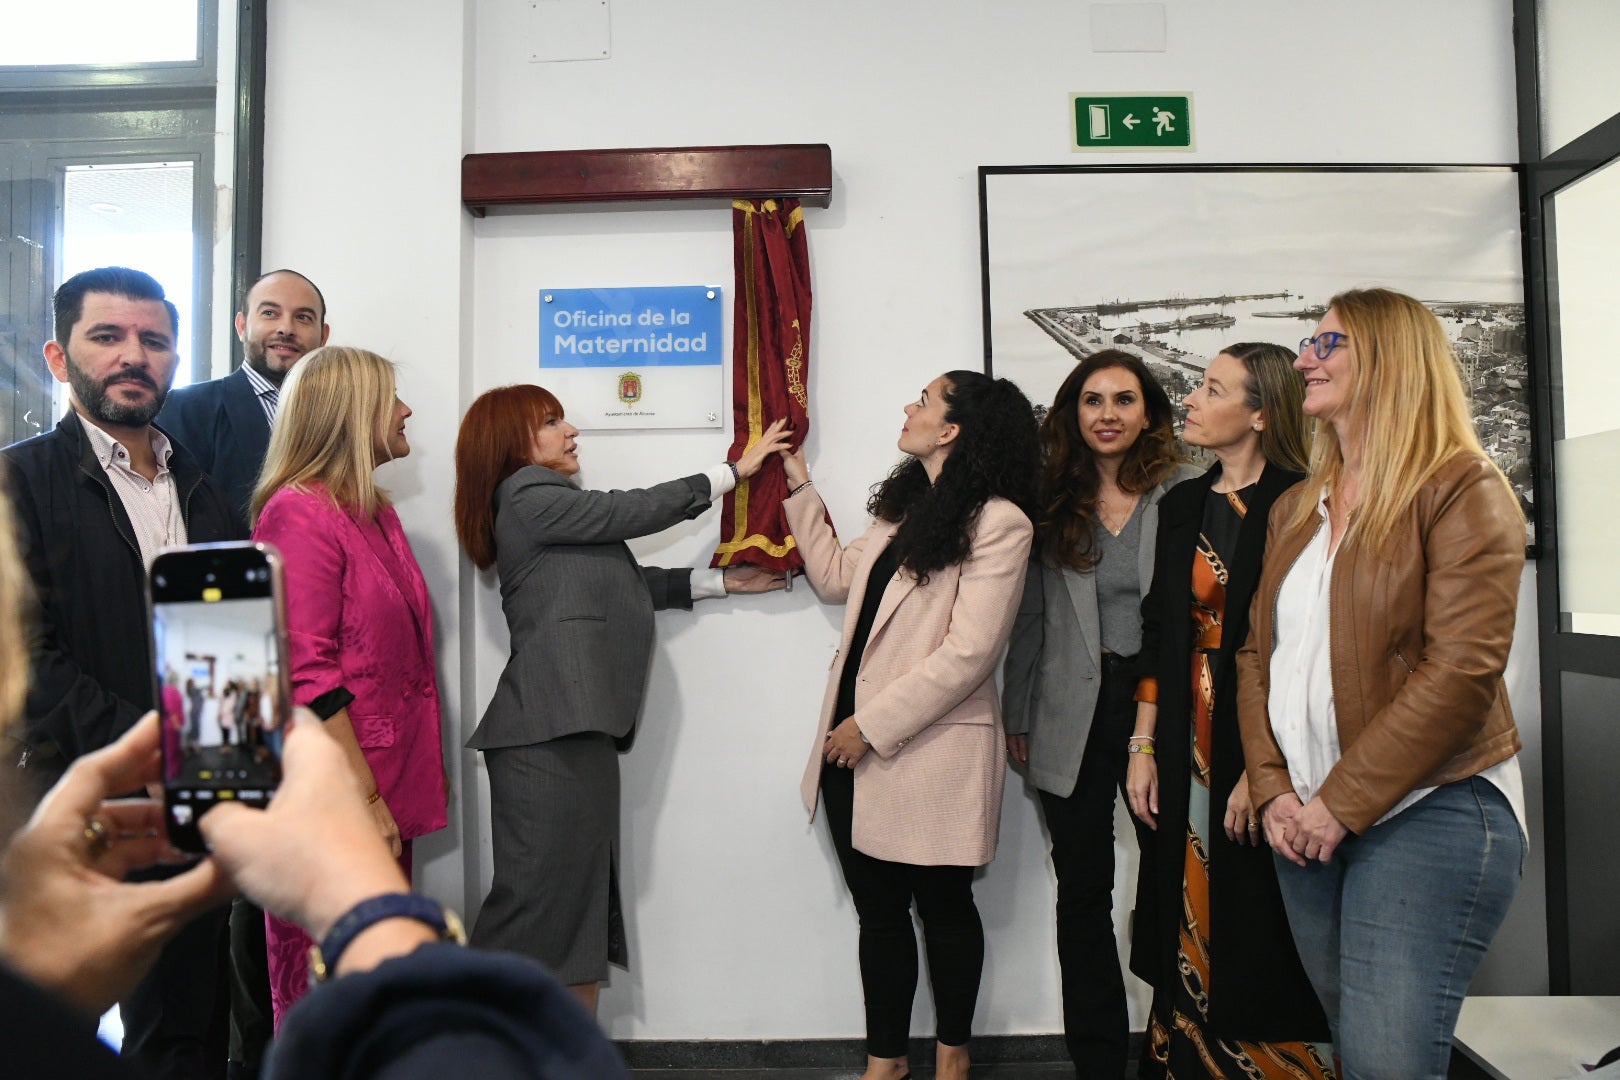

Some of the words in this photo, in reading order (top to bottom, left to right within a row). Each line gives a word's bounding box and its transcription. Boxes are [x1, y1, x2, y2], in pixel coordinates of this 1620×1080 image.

[553, 309, 632, 328] Oficina
[637, 308, 665, 326] de
[670, 308, 690, 326] la
[554, 332, 707, 355] Maternidad
